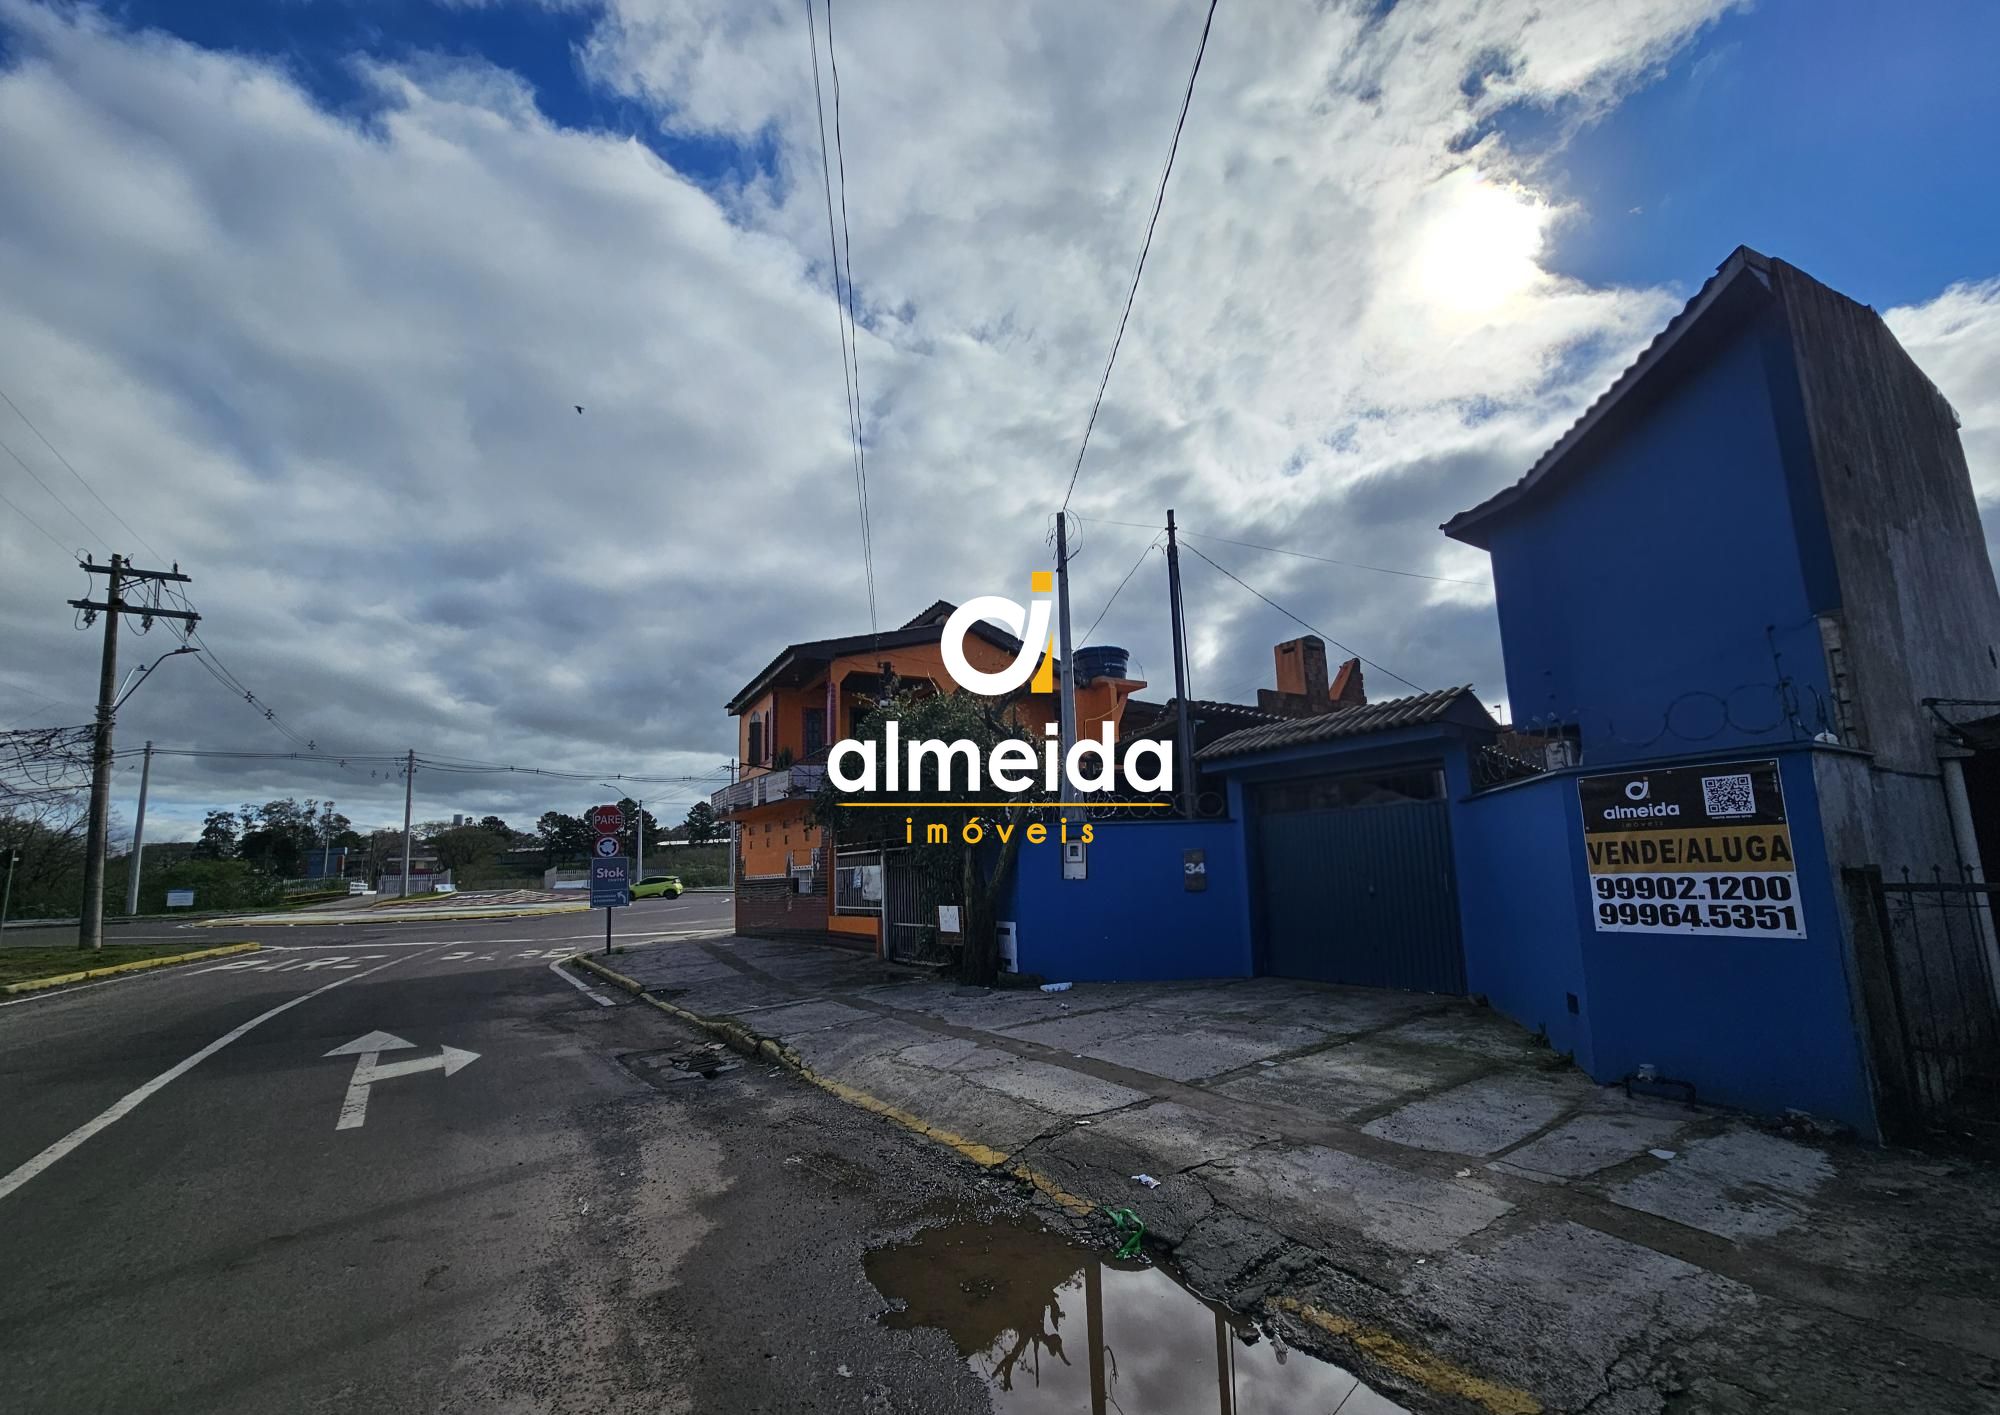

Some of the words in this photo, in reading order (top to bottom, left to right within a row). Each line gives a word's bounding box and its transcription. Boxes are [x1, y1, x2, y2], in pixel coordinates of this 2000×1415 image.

[594, 815, 621, 825] PARE
[1603, 802, 1680, 820] almeida
[1587, 834, 1793, 866] VENDE/ALUGA
[596, 867, 624, 878] Stok
[1184, 862, 1206, 875] 34
[1596, 876, 1792, 901] 99902.1200
[1598, 903, 1798, 931] 99964.5351
